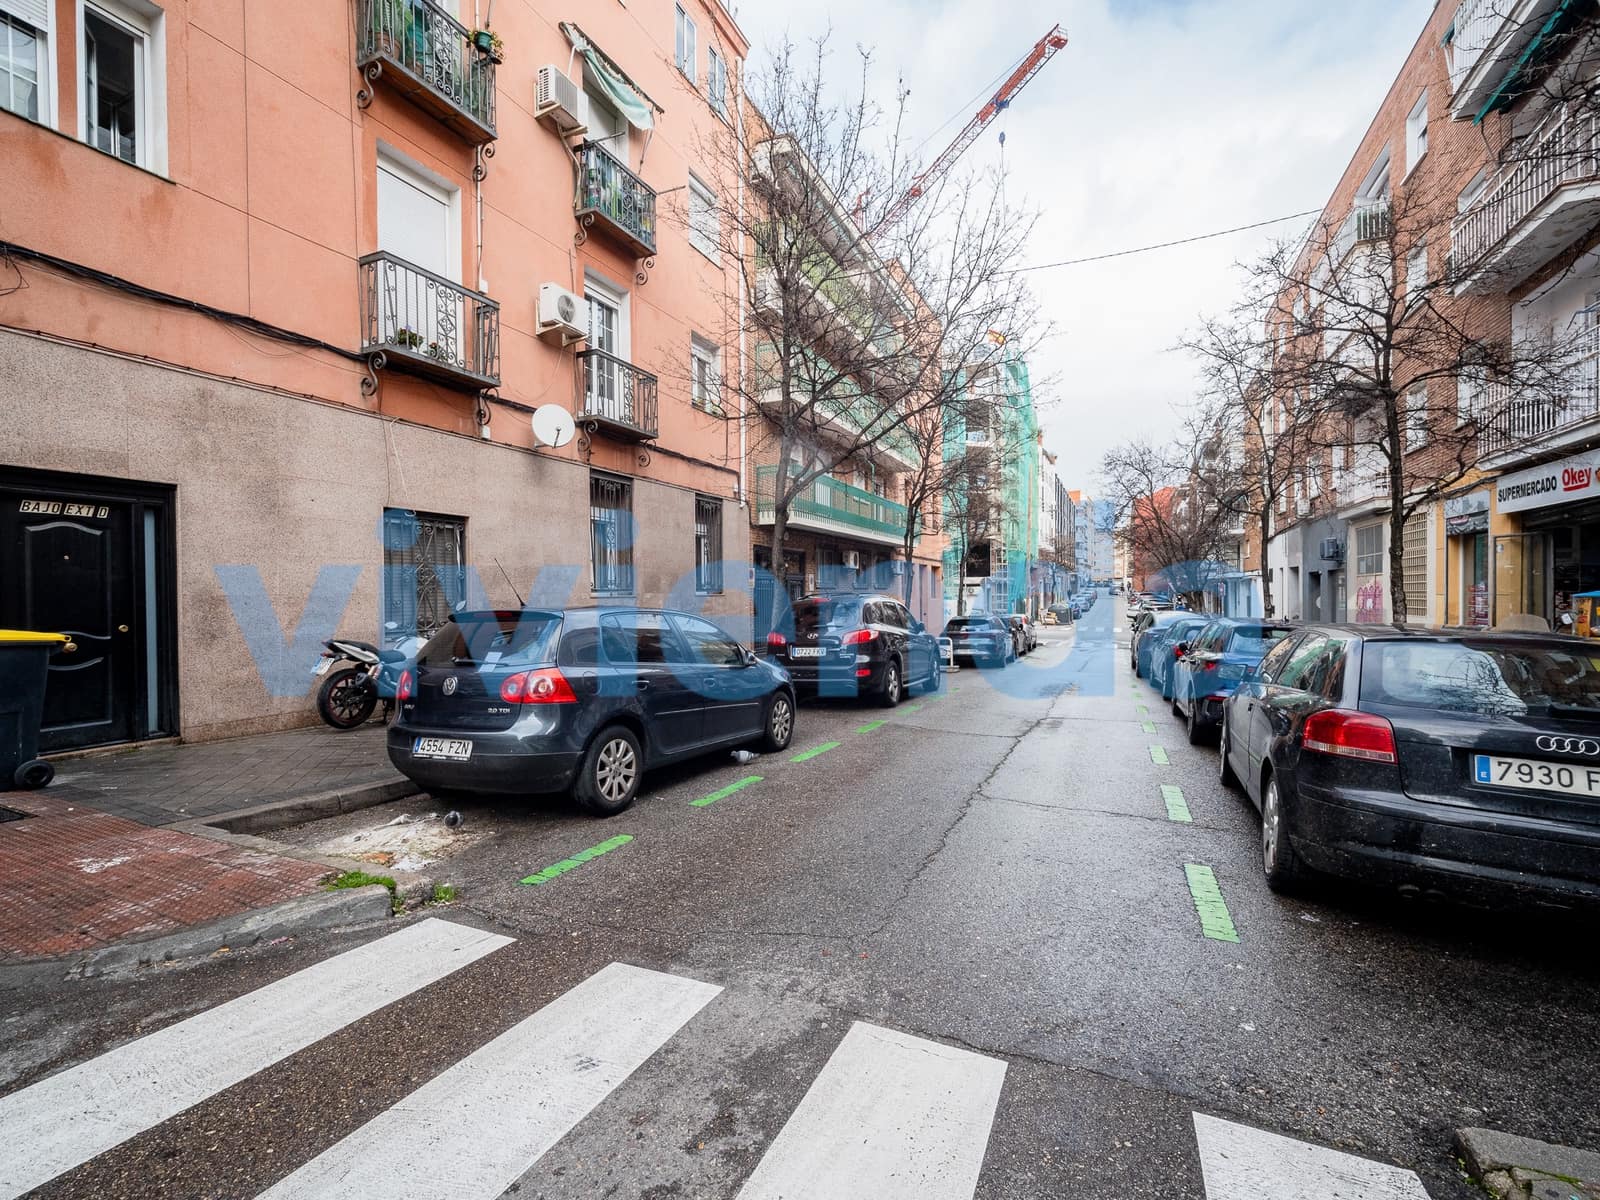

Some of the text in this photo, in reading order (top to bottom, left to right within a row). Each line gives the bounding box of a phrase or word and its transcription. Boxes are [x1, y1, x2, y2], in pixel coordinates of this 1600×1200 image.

[1497, 467, 1592, 502] SUPERMERCADO Okey
[21, 500, 108, 517] BAJO EXT D
[420, 739, 470, 755] 4554 FZN
[1497, 761, 1574, 788] 7930
